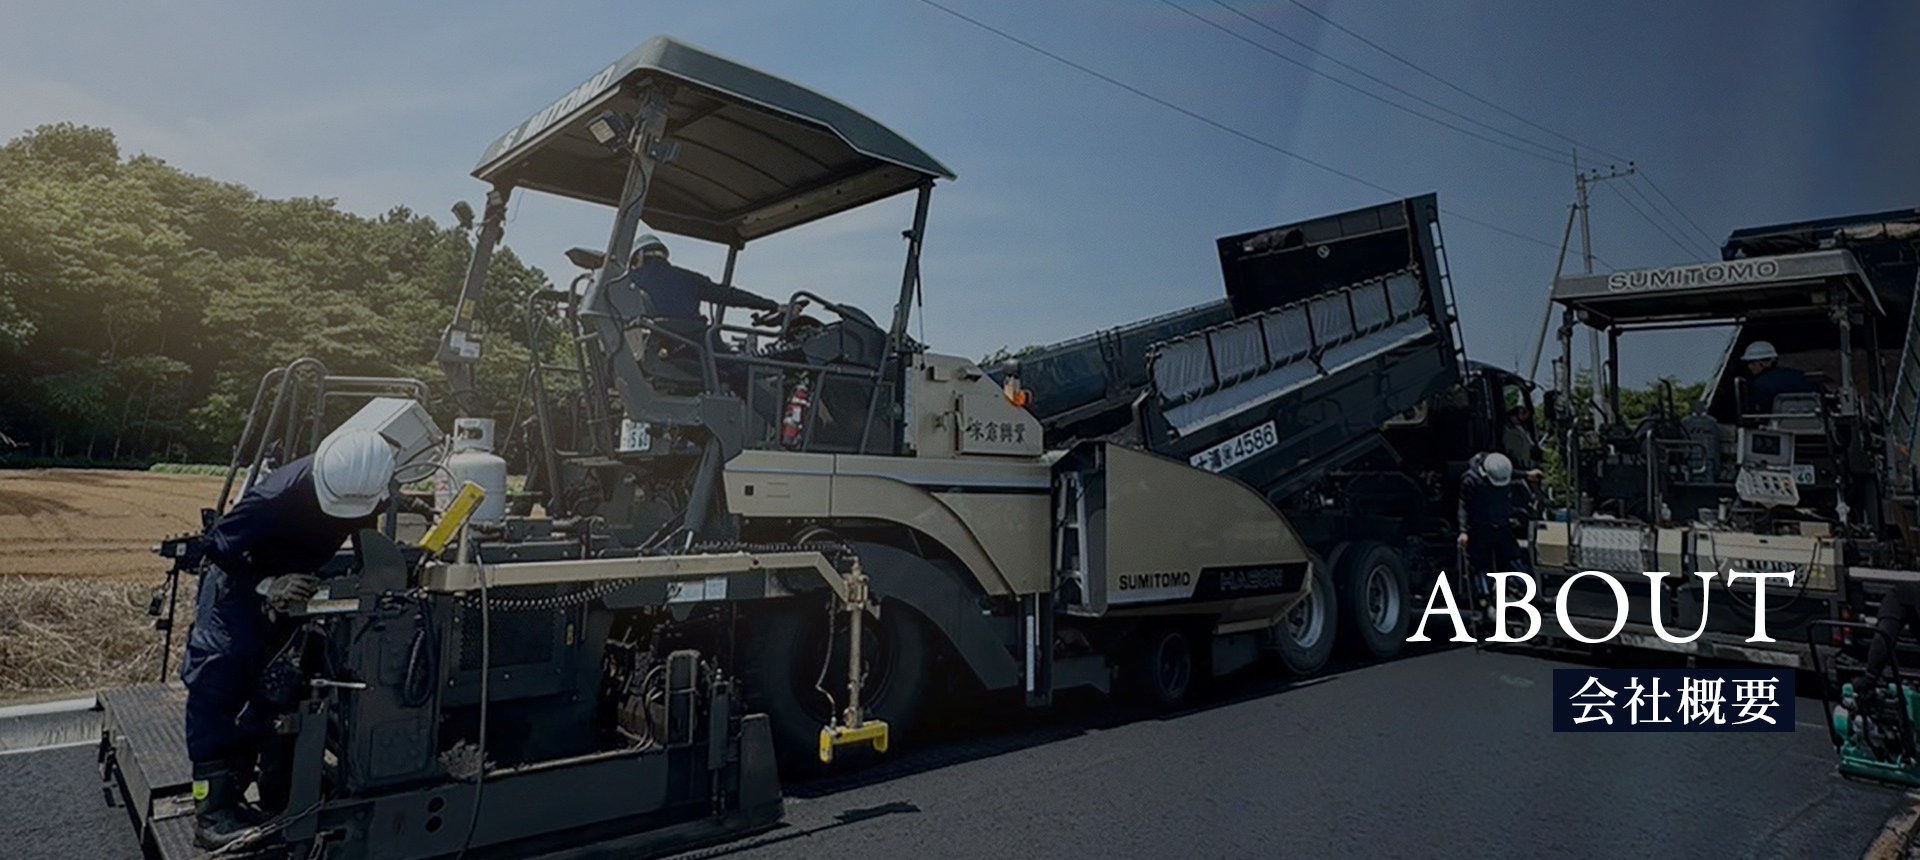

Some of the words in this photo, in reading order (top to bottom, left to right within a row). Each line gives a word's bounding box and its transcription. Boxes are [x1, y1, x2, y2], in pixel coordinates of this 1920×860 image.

[498, 64, 616, 155] SMITOMO
[1609, 262, 1777, 291] SUMITOMO
[1235, 424, 1274, 458] 4586
[1119, 572, 1190, 590] SUMITOMO
